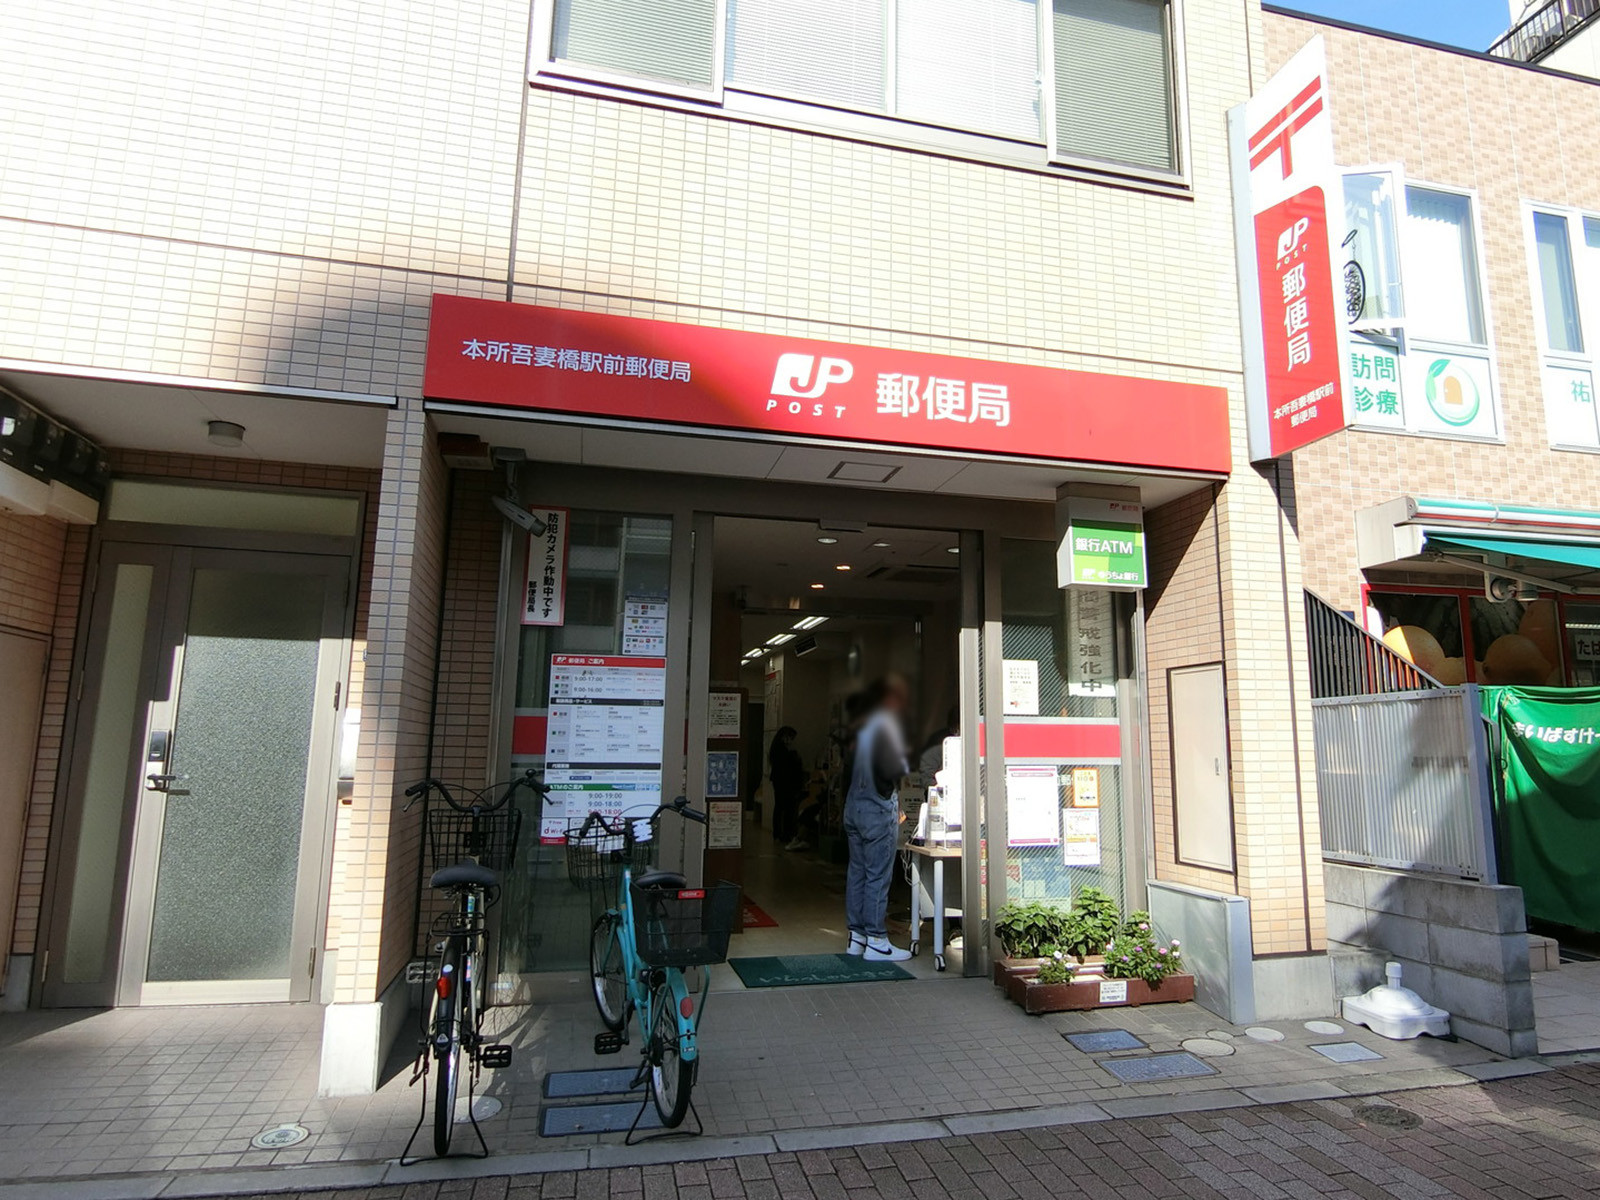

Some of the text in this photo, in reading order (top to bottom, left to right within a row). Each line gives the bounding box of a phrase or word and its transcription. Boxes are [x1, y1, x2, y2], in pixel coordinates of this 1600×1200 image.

[1275, 243, 1308, 271] POST
[1281, 262, 1311, 373] 郵便局
[461, 338, 692, 383] 本所吾妻橋駅前郵便局
[770, 352, 854, 399] JP
[1351, 353, 1396, 382] 訪問
[875, 372, 1011, 427] 郵便局
[1273, 381, 1335, 420] 本所吾妻橋駅前
[1354, 386, 1399, 415] 診療
[1571, 380, 1591, 403] 祐
[765, 399, 846, 419] POST
[1290, 406, 1318, 428] 郵便局
[1074, 537, 1133, 555] 銀行ATM
[542, 513, 559, 618] 防犯カメラ作動中です
[527, 581, 537, 613] 郵便局長
